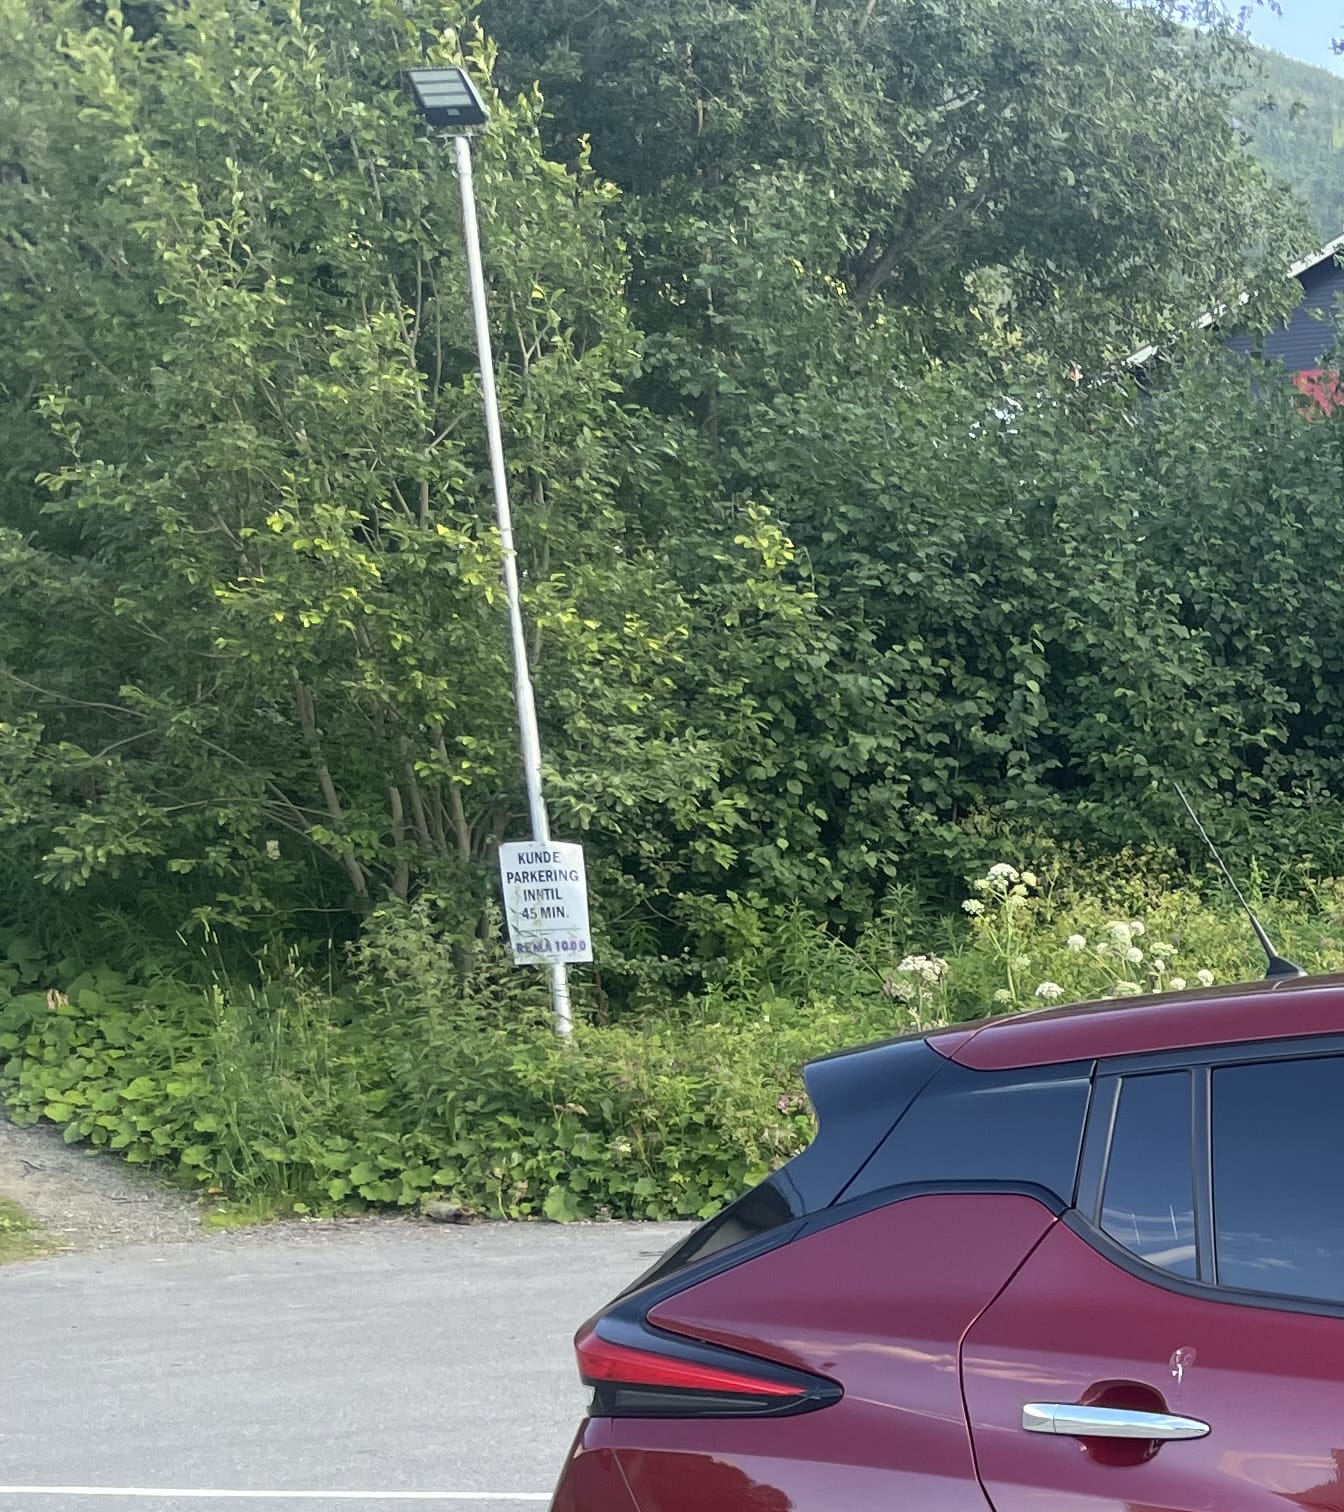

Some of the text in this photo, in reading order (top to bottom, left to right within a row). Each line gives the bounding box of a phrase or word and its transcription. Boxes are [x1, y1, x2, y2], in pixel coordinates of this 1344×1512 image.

[518, 851, 561, 865] KUNDE
[507, 869, 579, 884] PARKERING
[523, 888, 563, 901] INNTIL
[521, 906, 570, 919] 45 MIN.
